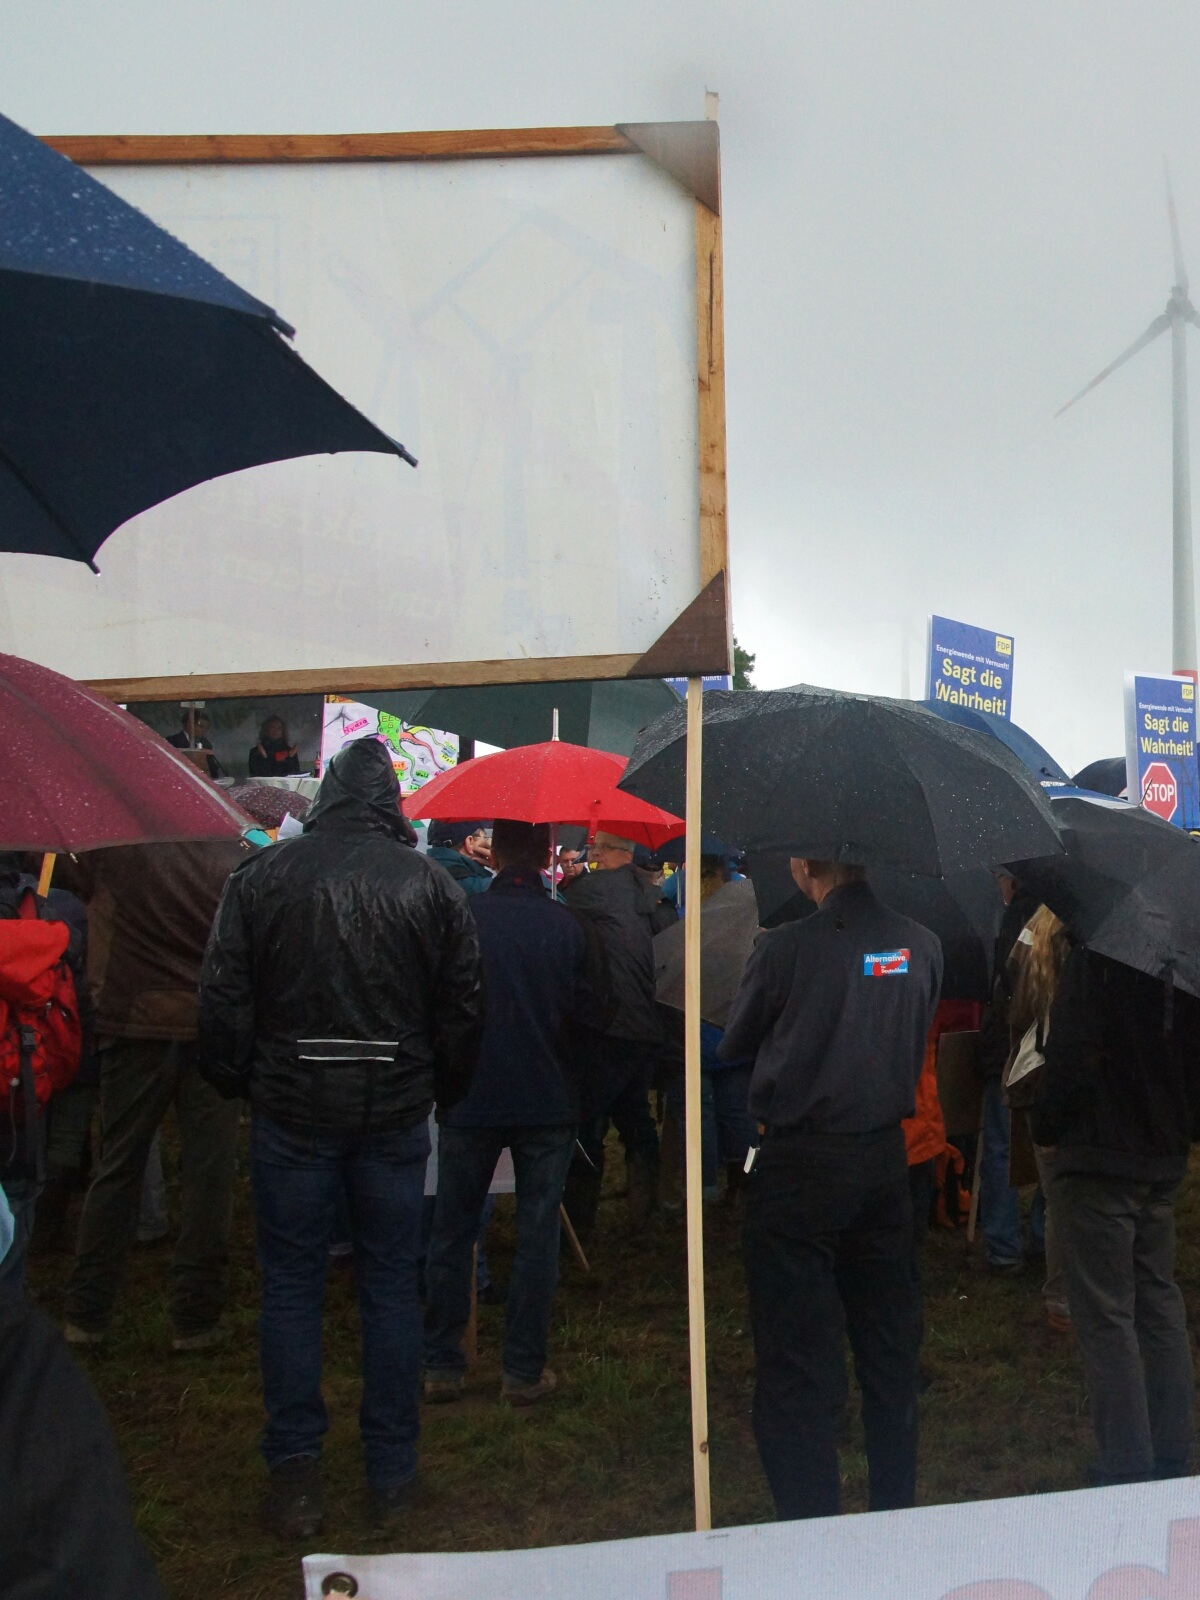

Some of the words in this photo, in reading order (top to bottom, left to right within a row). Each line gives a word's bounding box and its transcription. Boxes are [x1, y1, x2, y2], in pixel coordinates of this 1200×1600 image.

[996, 641, 1011, 651] FDP
[942, 658, 977, 686] Sagt
[980, 669, 1003, 690] die
[936, 682, 1007, 716] Wahrheit!
[1182, 688, 1193, 696] FDP
[1144, 714, 1169, 735] Sagt
[1172, 716, 1189, 733] die
[1140, 736, 1194, 756] Wahrheit!
[1145, 783, 1175, 802] STOP
[865, 953, 906, 964] Alternative
